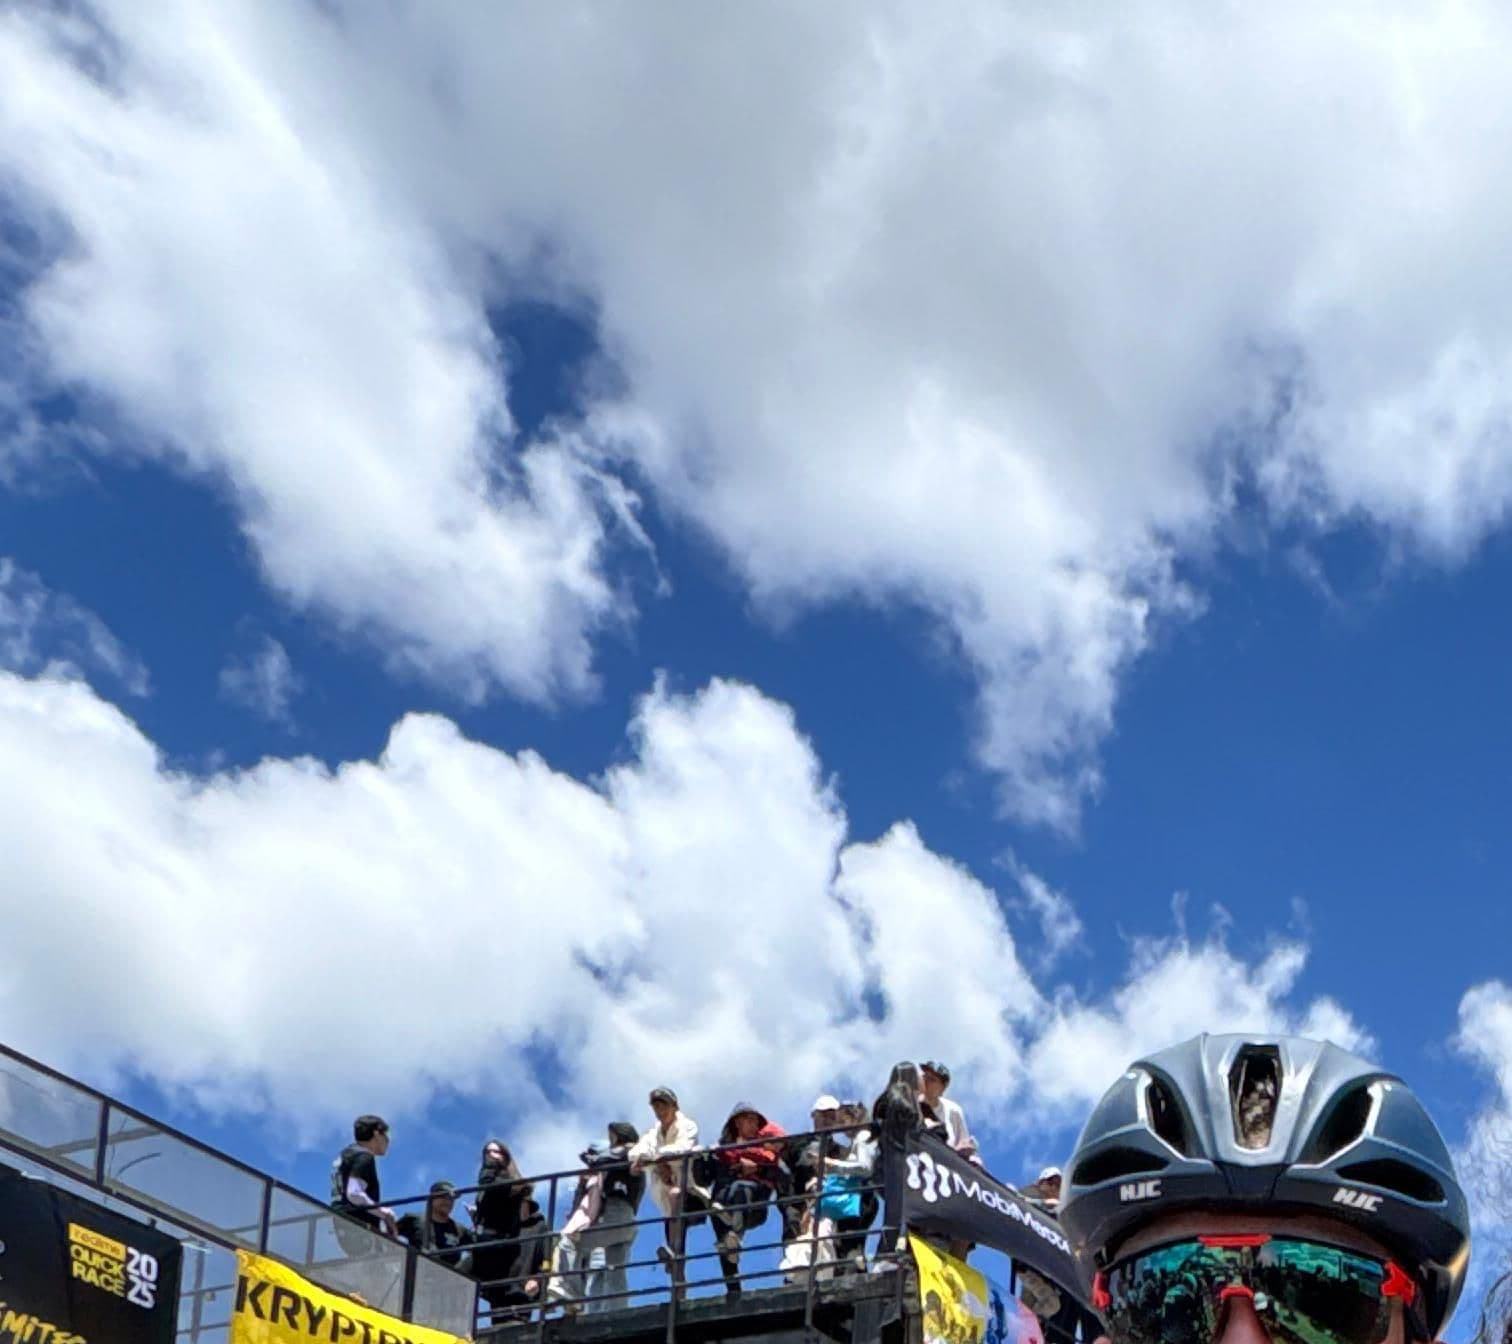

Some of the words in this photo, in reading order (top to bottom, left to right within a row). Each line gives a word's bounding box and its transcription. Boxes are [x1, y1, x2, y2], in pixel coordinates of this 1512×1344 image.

[70, 1244, 126, 1279] QUICK
[72, 1261, 126, 1297] RACE
[126, 1247, 158, 1283] 20
[127, 1275, 157, 1309] 25
